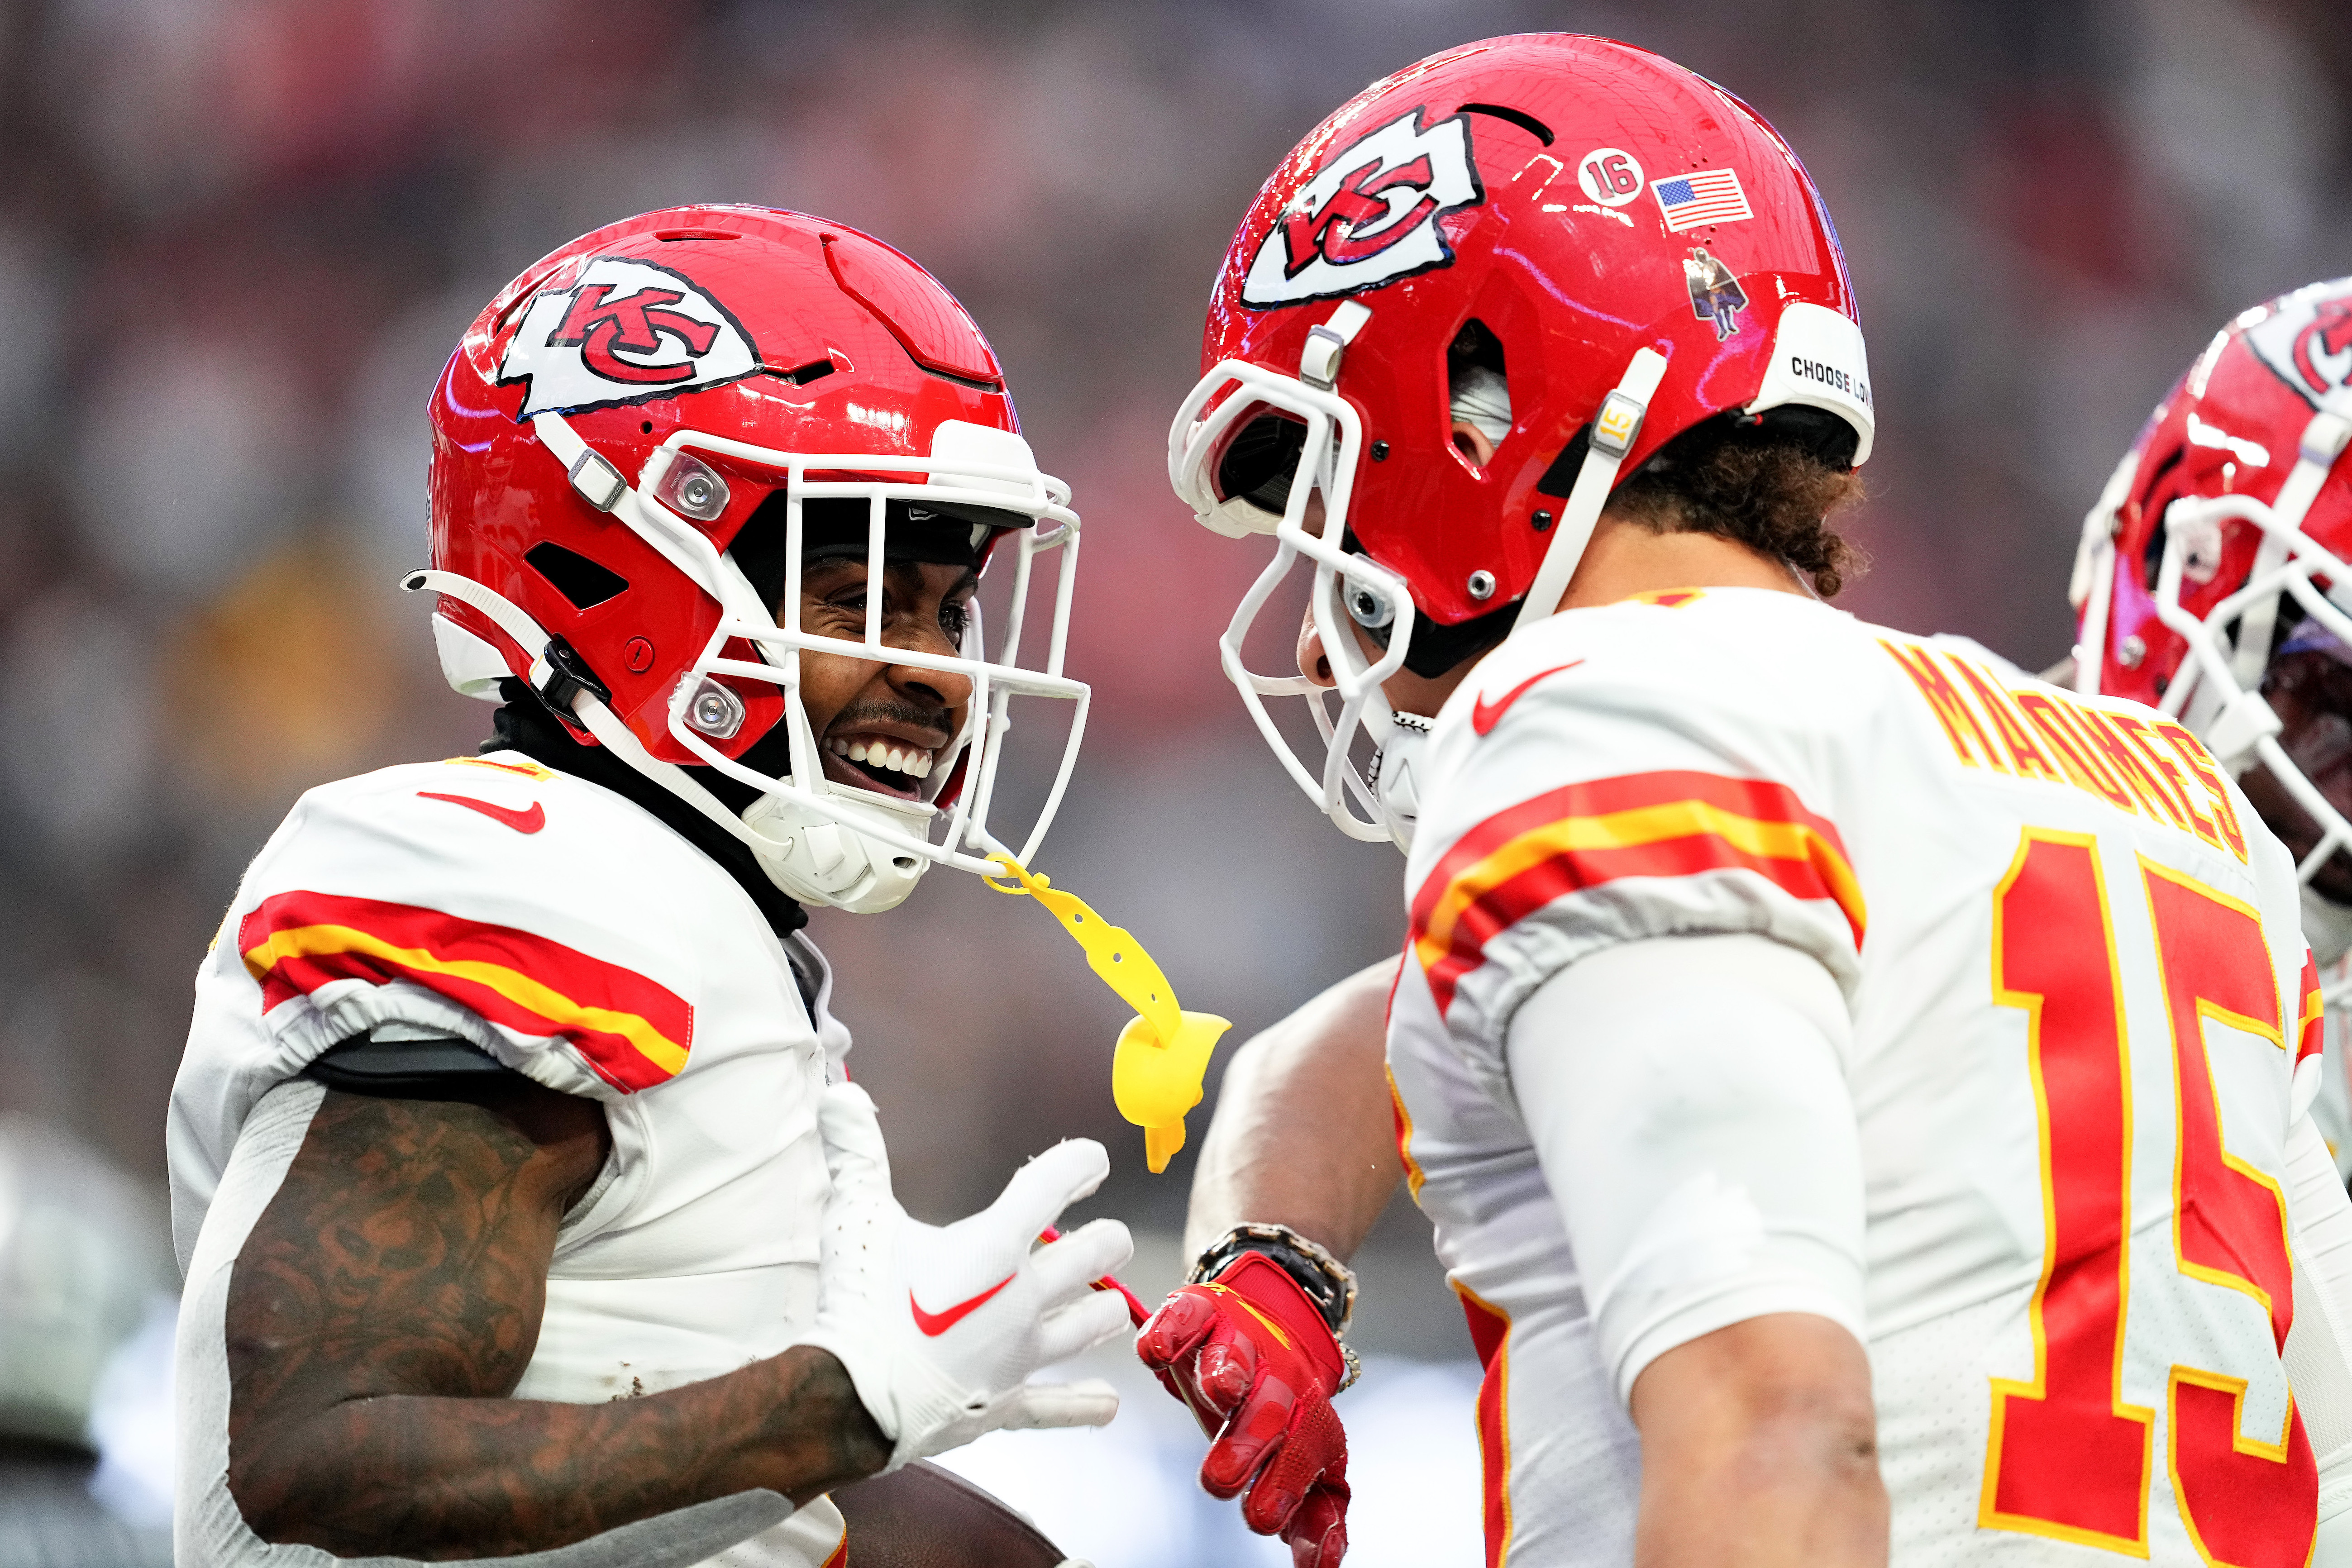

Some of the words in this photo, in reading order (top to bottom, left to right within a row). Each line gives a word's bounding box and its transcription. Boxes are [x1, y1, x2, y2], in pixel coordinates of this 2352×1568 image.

[1278, 152, 1440, 281] KC
[1586, 154, 1638, 199] 16
[544, 283, 721, 385] KC
[1792, 357, 1850, 393] CHOOSE
[1600, 408, 1632, 442] 15
[1875, 639, 2248, 865] MAOMES
[1977, 825, 2319, 1568] 15
